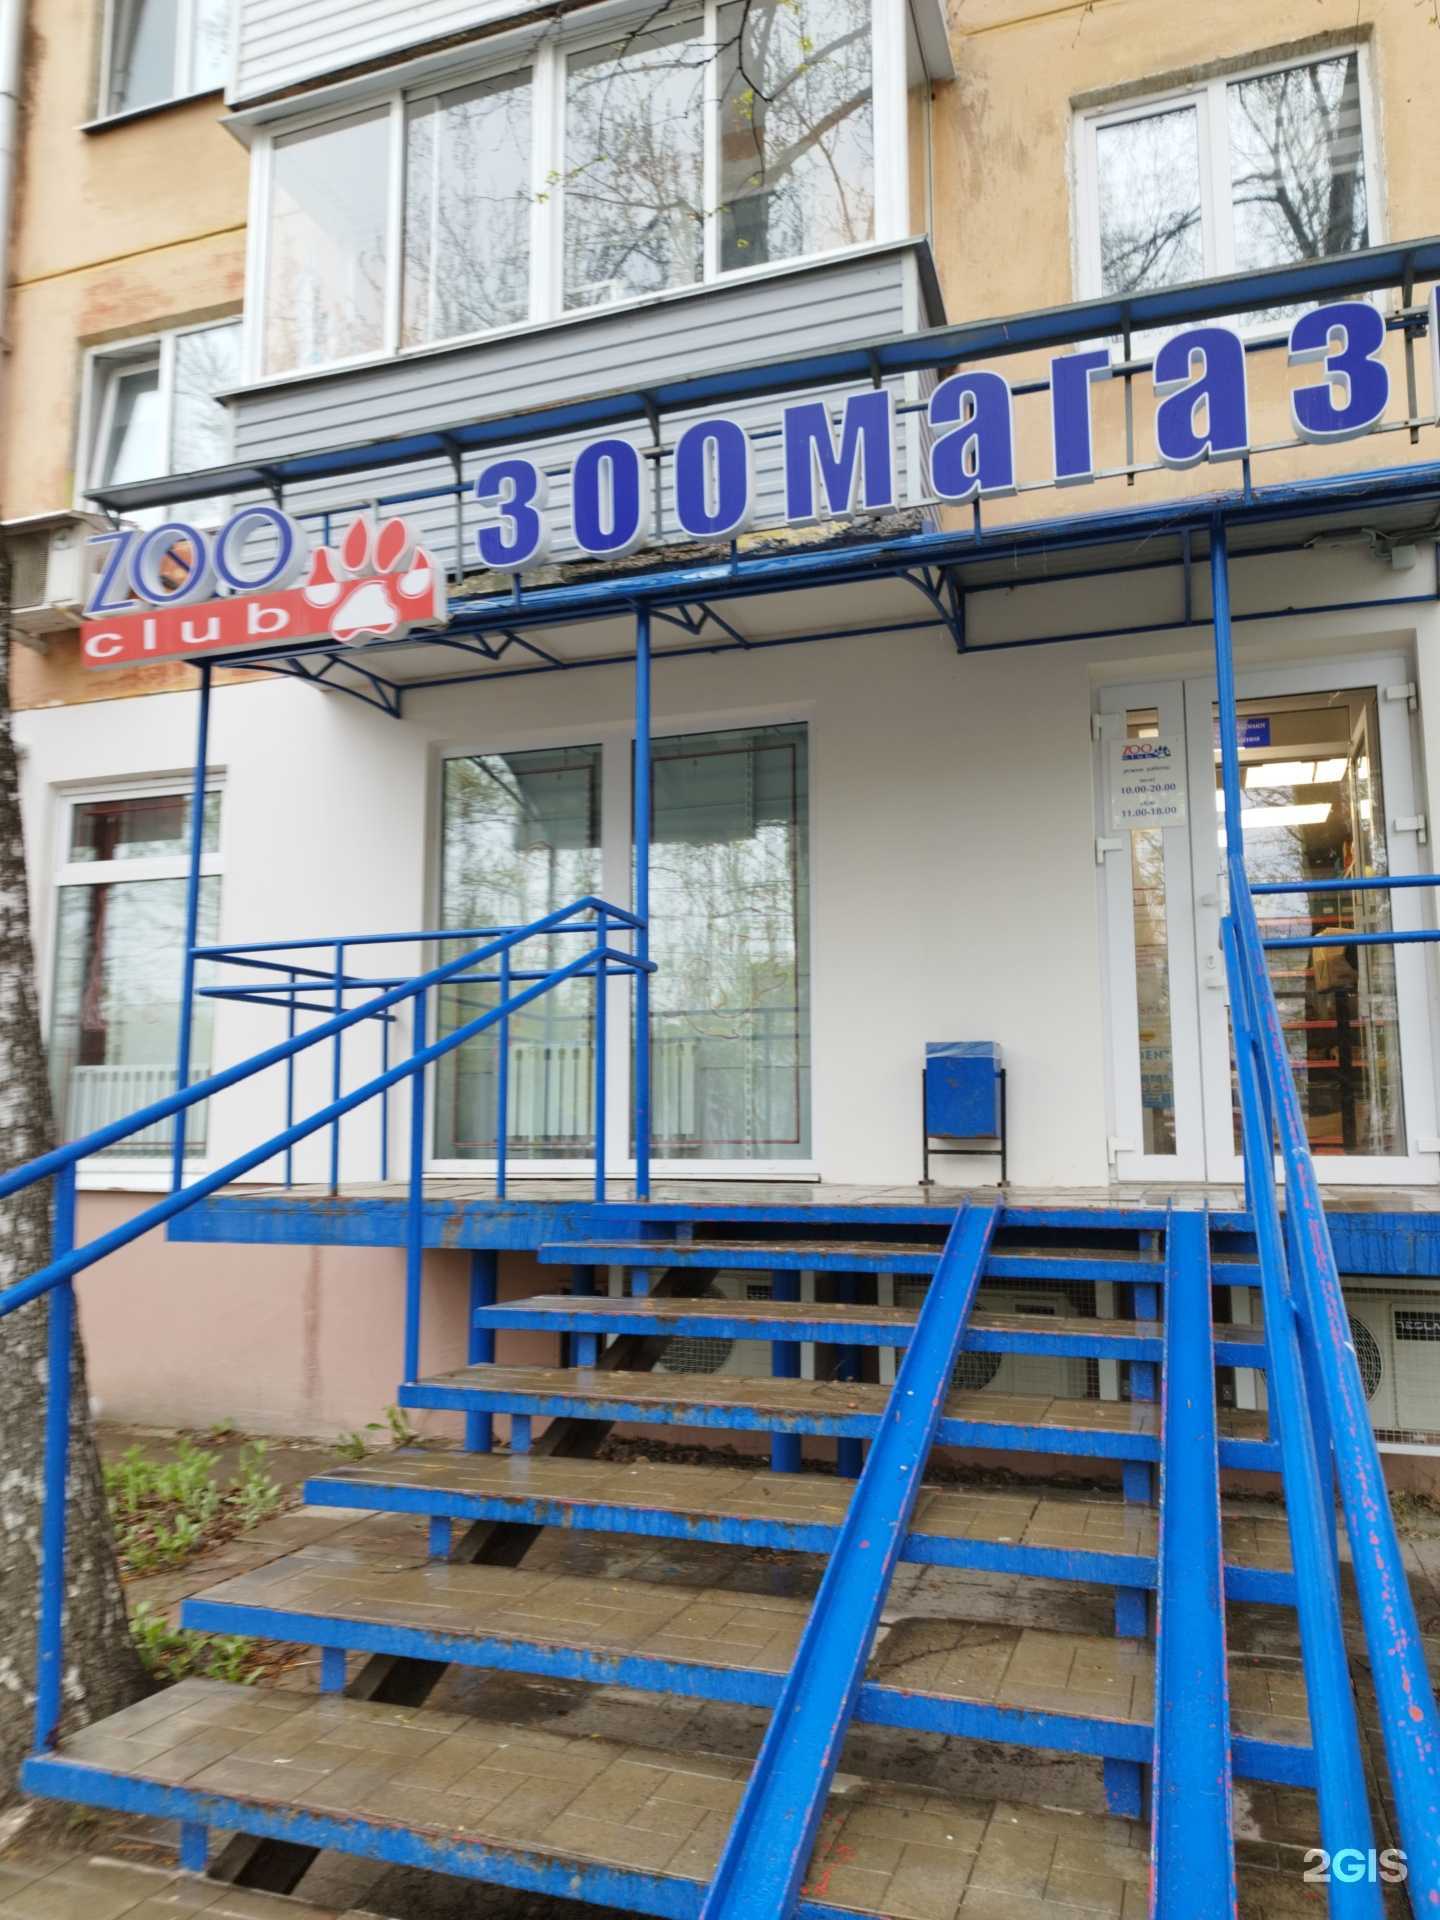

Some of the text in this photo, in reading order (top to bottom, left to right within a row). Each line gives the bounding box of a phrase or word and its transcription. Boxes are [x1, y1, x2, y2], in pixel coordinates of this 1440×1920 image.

[85, 504, 298, 616] ZOO
[83, 602, 291, 659] club
[1120, 783, 1177, 795] 10.00-20.00
